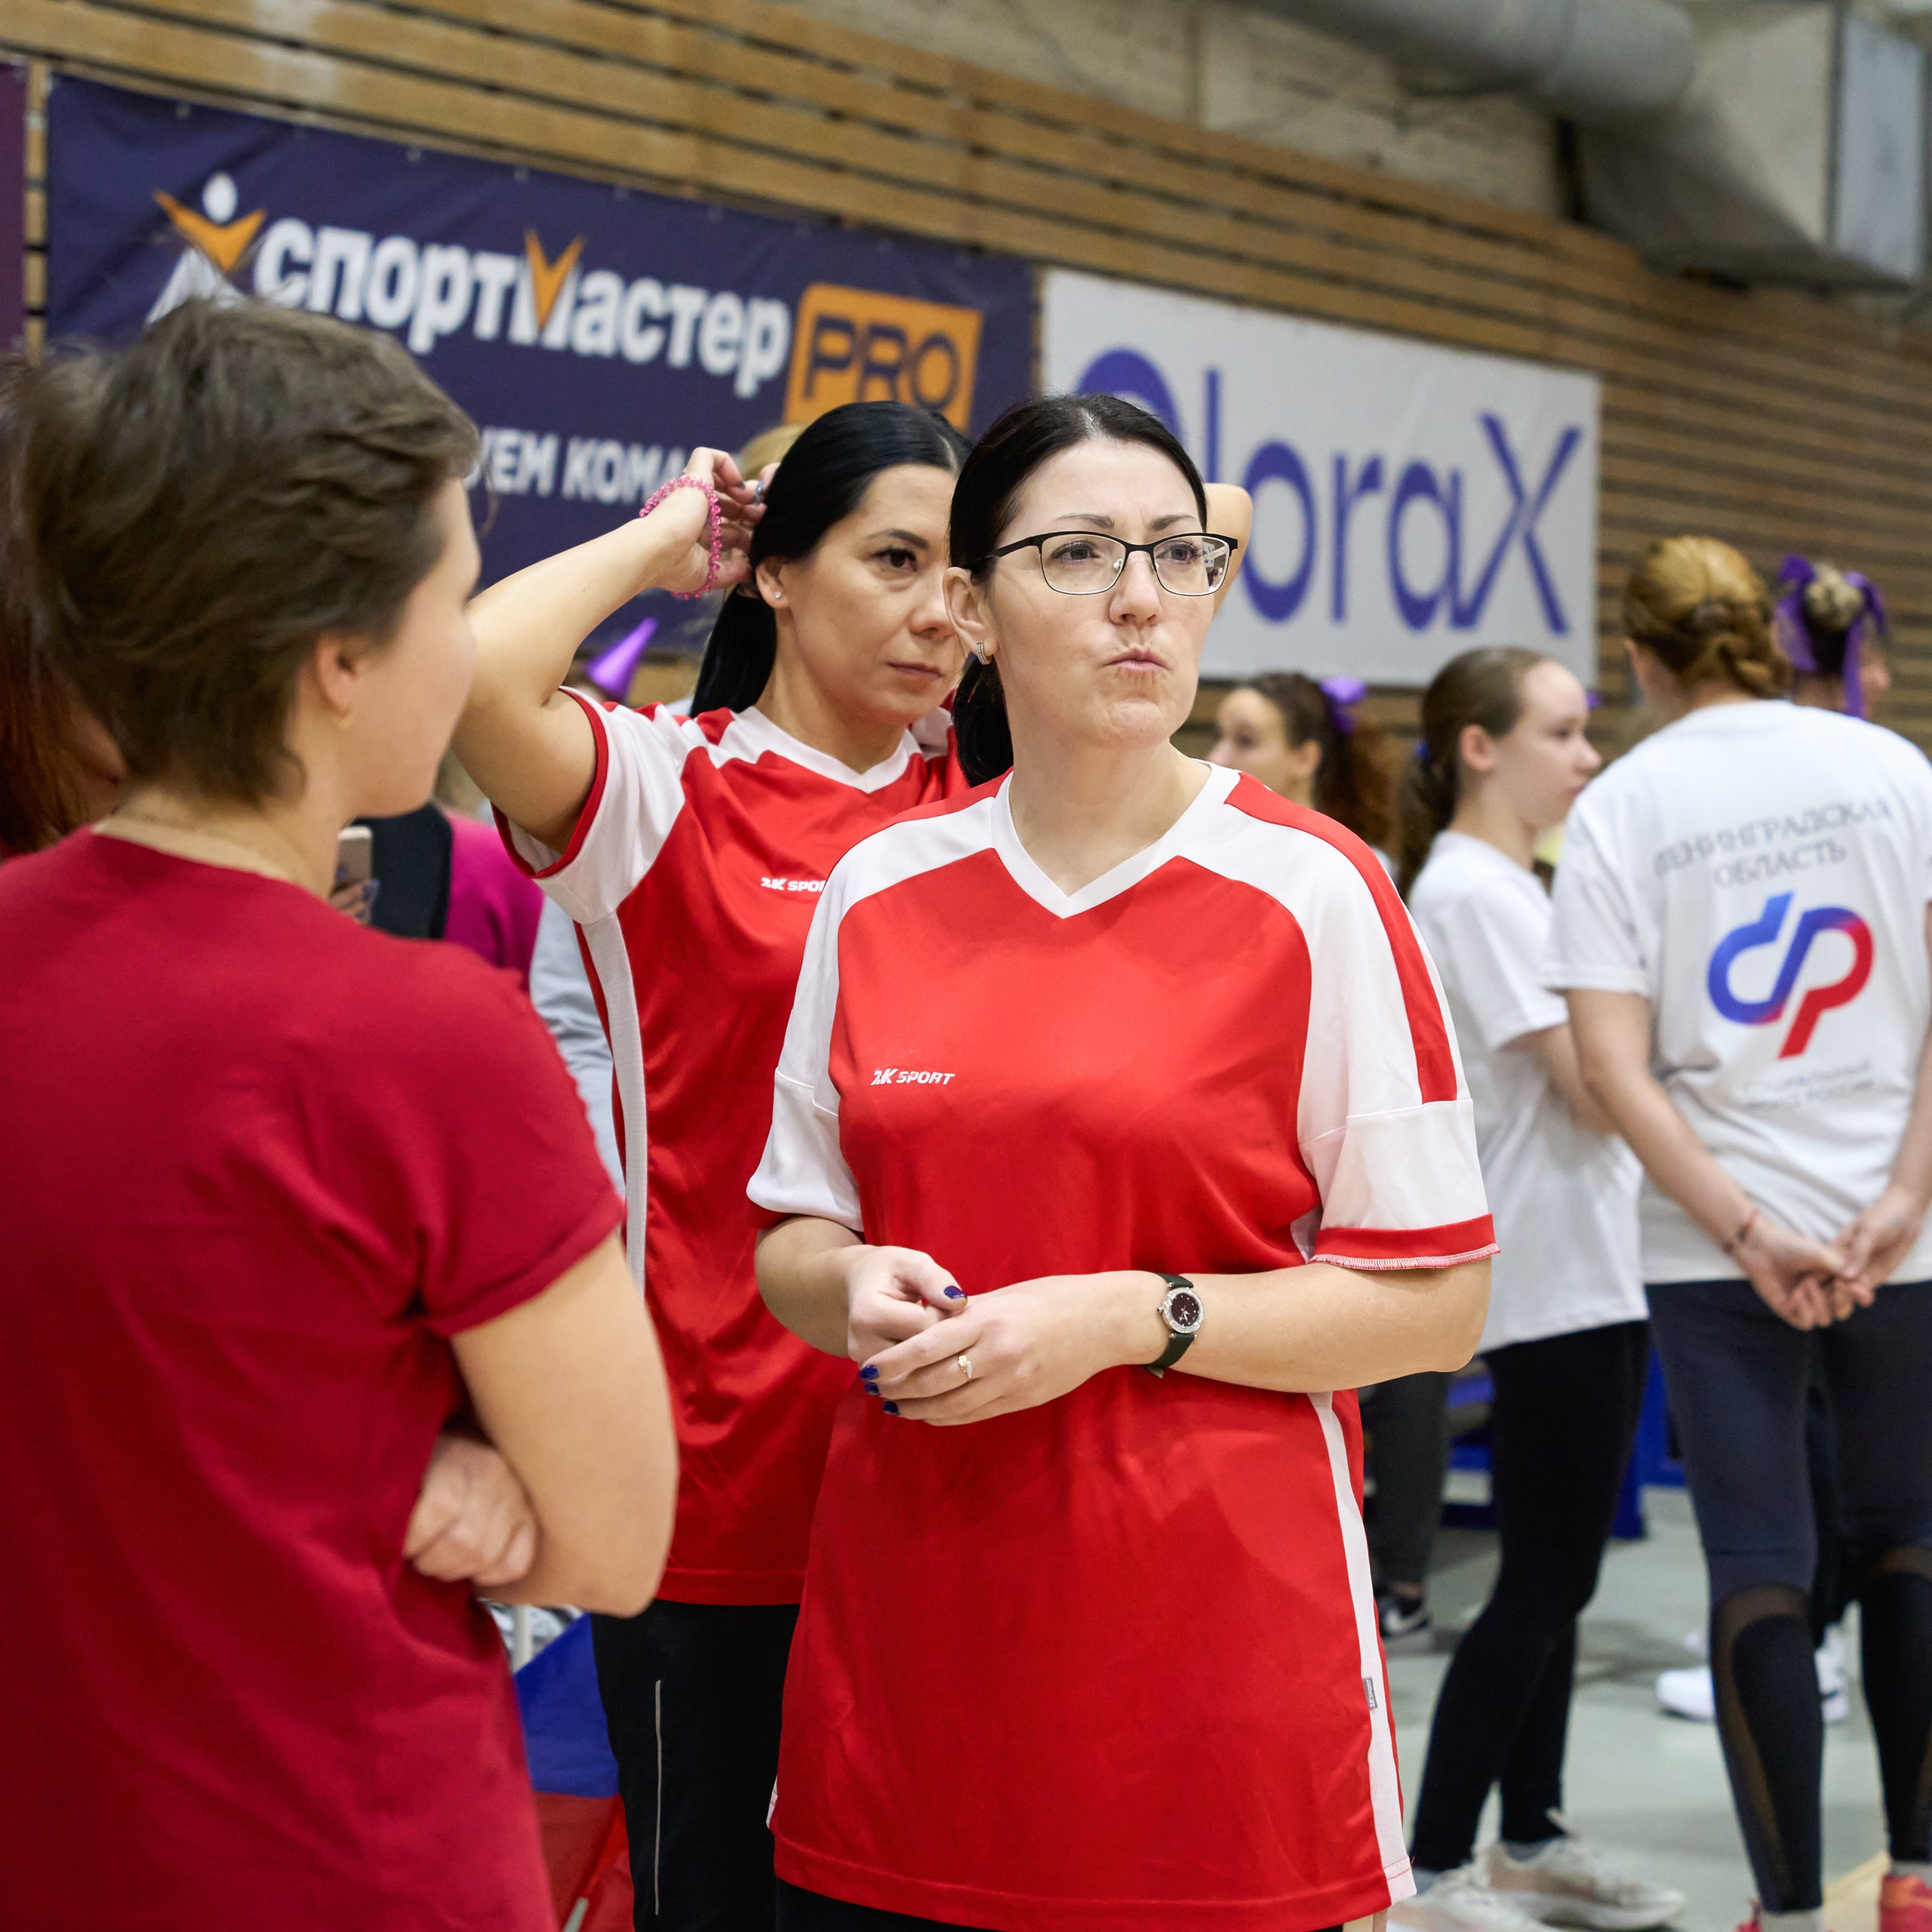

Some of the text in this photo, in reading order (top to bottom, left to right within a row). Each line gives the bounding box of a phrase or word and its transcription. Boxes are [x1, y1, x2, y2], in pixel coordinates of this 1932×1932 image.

[804, 313, 958, 411] PRO
[1075, 346, 1581, 637] loraX
[1714, 838, 1847, 889] ОБЛАСТЬ
[896, 1071, 955, 1085] SPORT
